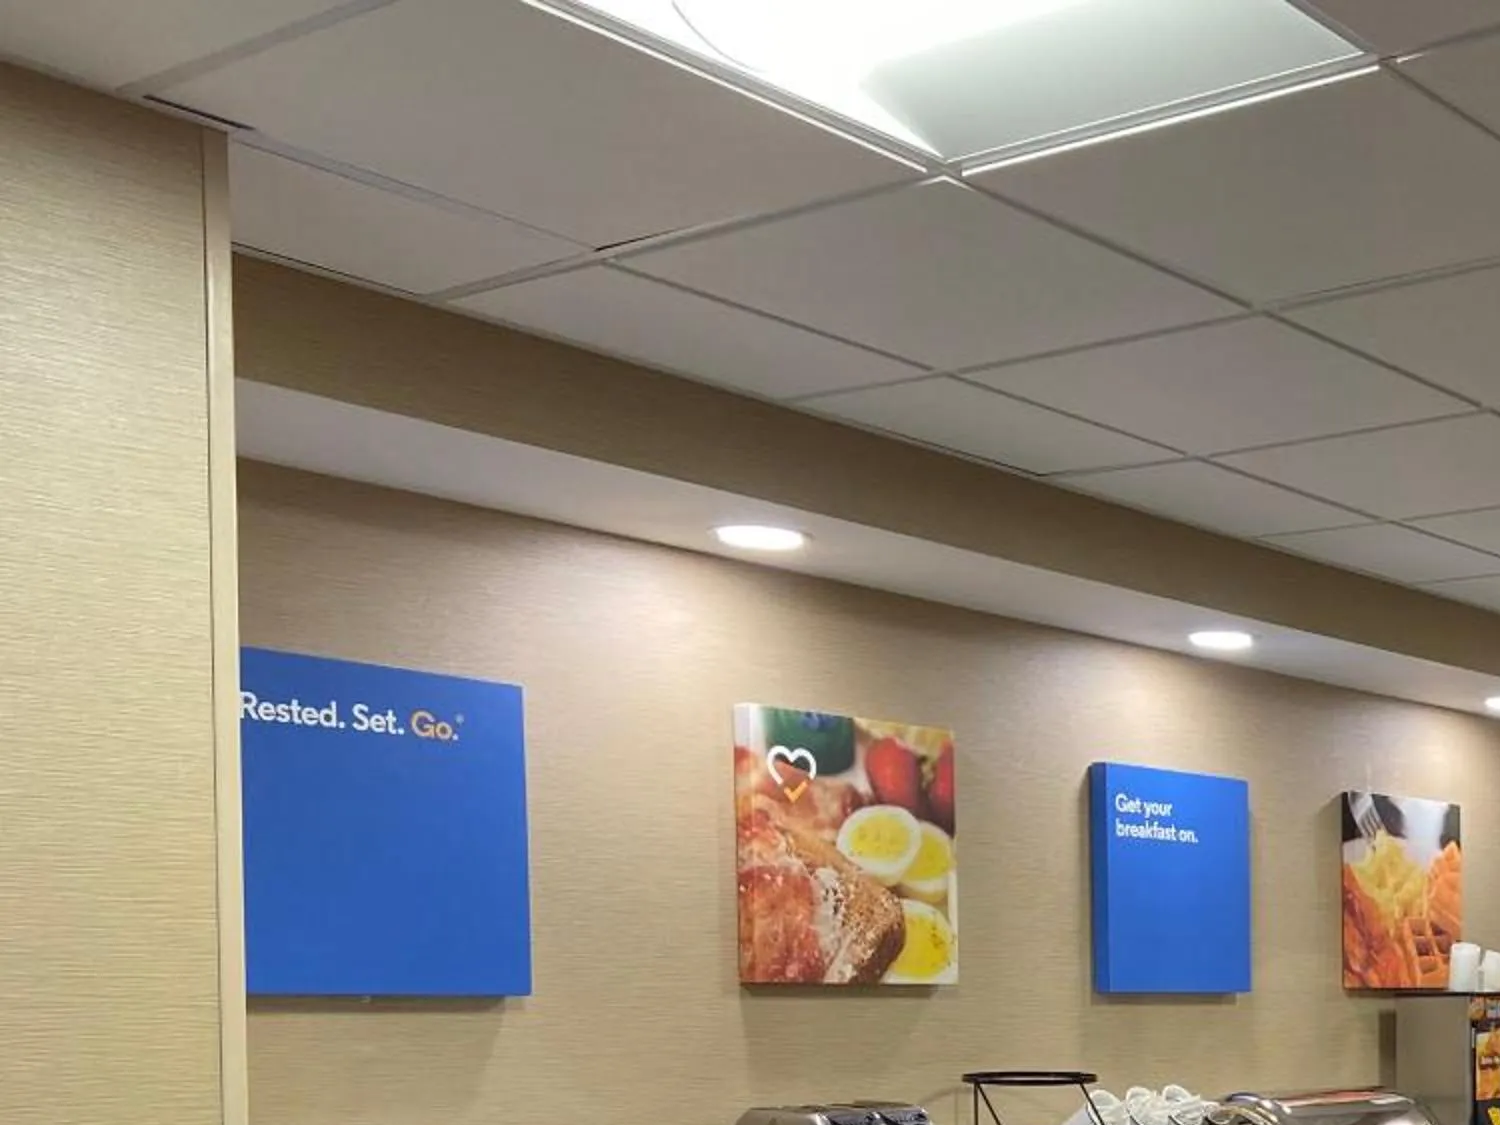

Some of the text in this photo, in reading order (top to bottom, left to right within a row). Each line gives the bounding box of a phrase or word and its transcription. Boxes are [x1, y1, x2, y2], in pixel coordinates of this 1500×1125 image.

[240, 691, 346, 729] Rested.
[352, 703, 405, 735] Set.
[1115, 793, 1173, 819] Get your
[1115, 818, 1199, 843] breakfast on.
